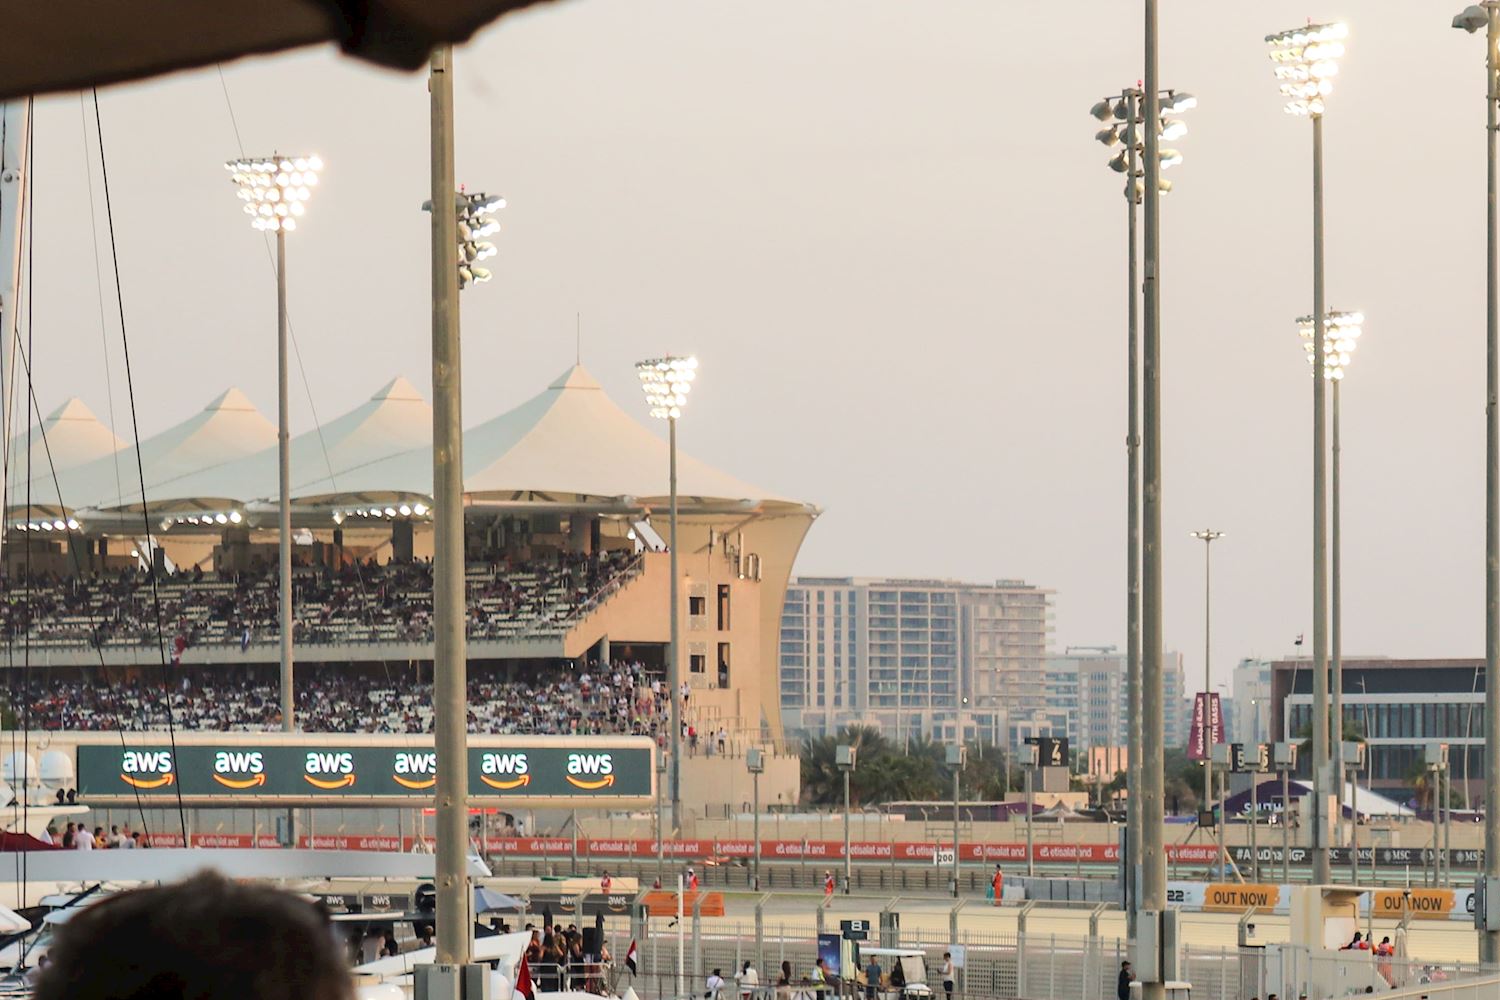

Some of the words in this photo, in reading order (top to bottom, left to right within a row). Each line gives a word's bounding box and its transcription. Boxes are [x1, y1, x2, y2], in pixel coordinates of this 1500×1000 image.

[122, 751, 172, 773] aws
[214, 751, 264, 773] aws
[305, 752, 354, 774] aws
[481, 752, 529, 774] aws
[567, 753, 613, 775] aws
[938, 854, 953, 863] 200
[985, 846, 1009, 857] tisalat
[1392, 850, 1411, 860] MSC
[1214, 890, 1237, 905] OUT
[1240, 892, 1268, 906] NOW
[1412, 897, 1442, 911] NOW
[851, 920, 863, 932] 8
